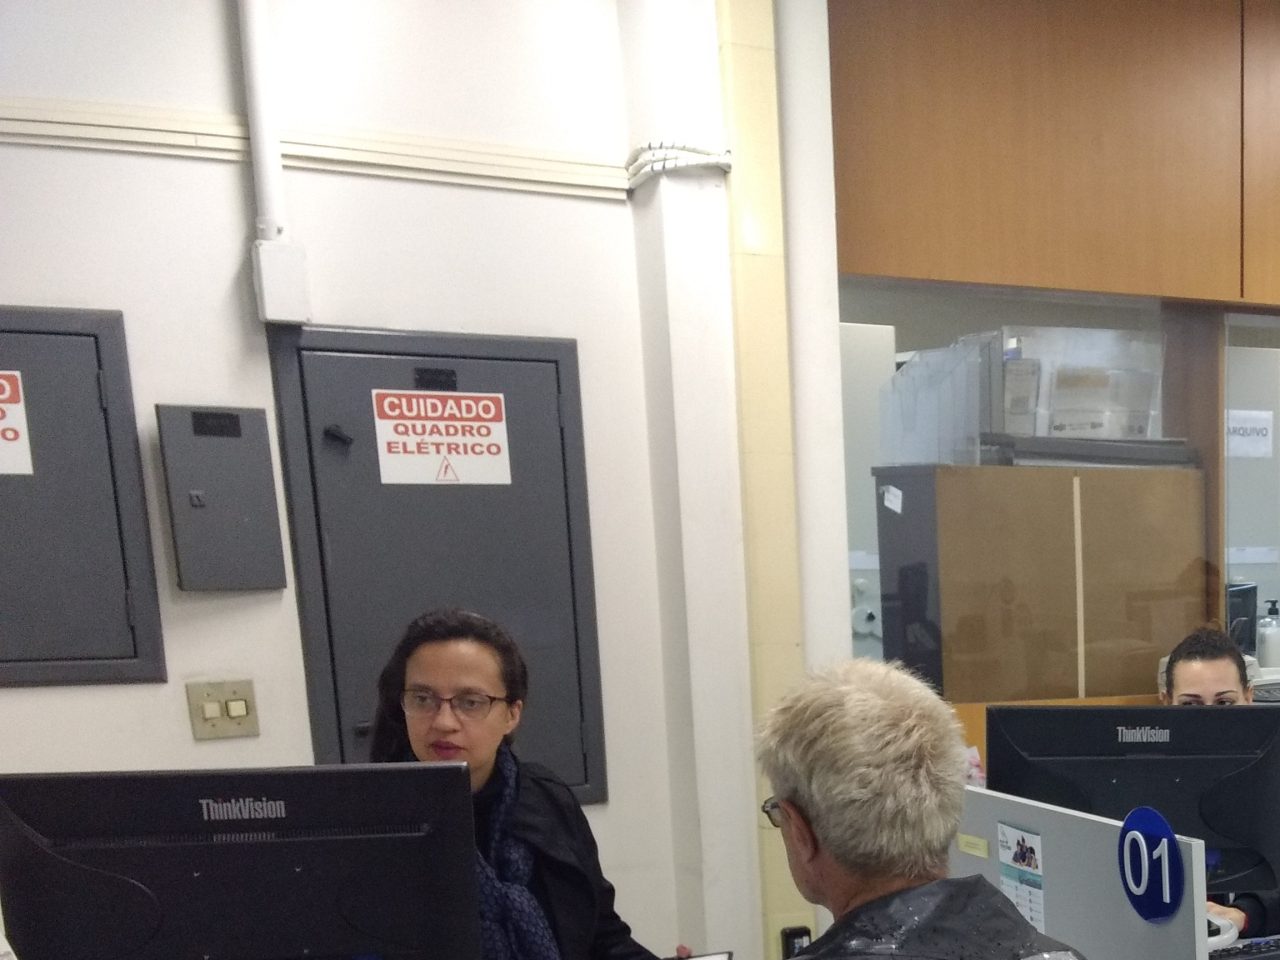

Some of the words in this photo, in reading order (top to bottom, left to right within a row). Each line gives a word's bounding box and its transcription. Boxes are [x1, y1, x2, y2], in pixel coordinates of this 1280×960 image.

[383, 396, 496, 419] CUIDADO
[392, 423, 492, 438] QUADRO
[386, 439, 502, 456] ELÉTRICO
[1116, 726, 1170, 743] ThinkVision
[199, 797, 286, 820] ThinkVision
[1124, 830, 1170, 904] 01
